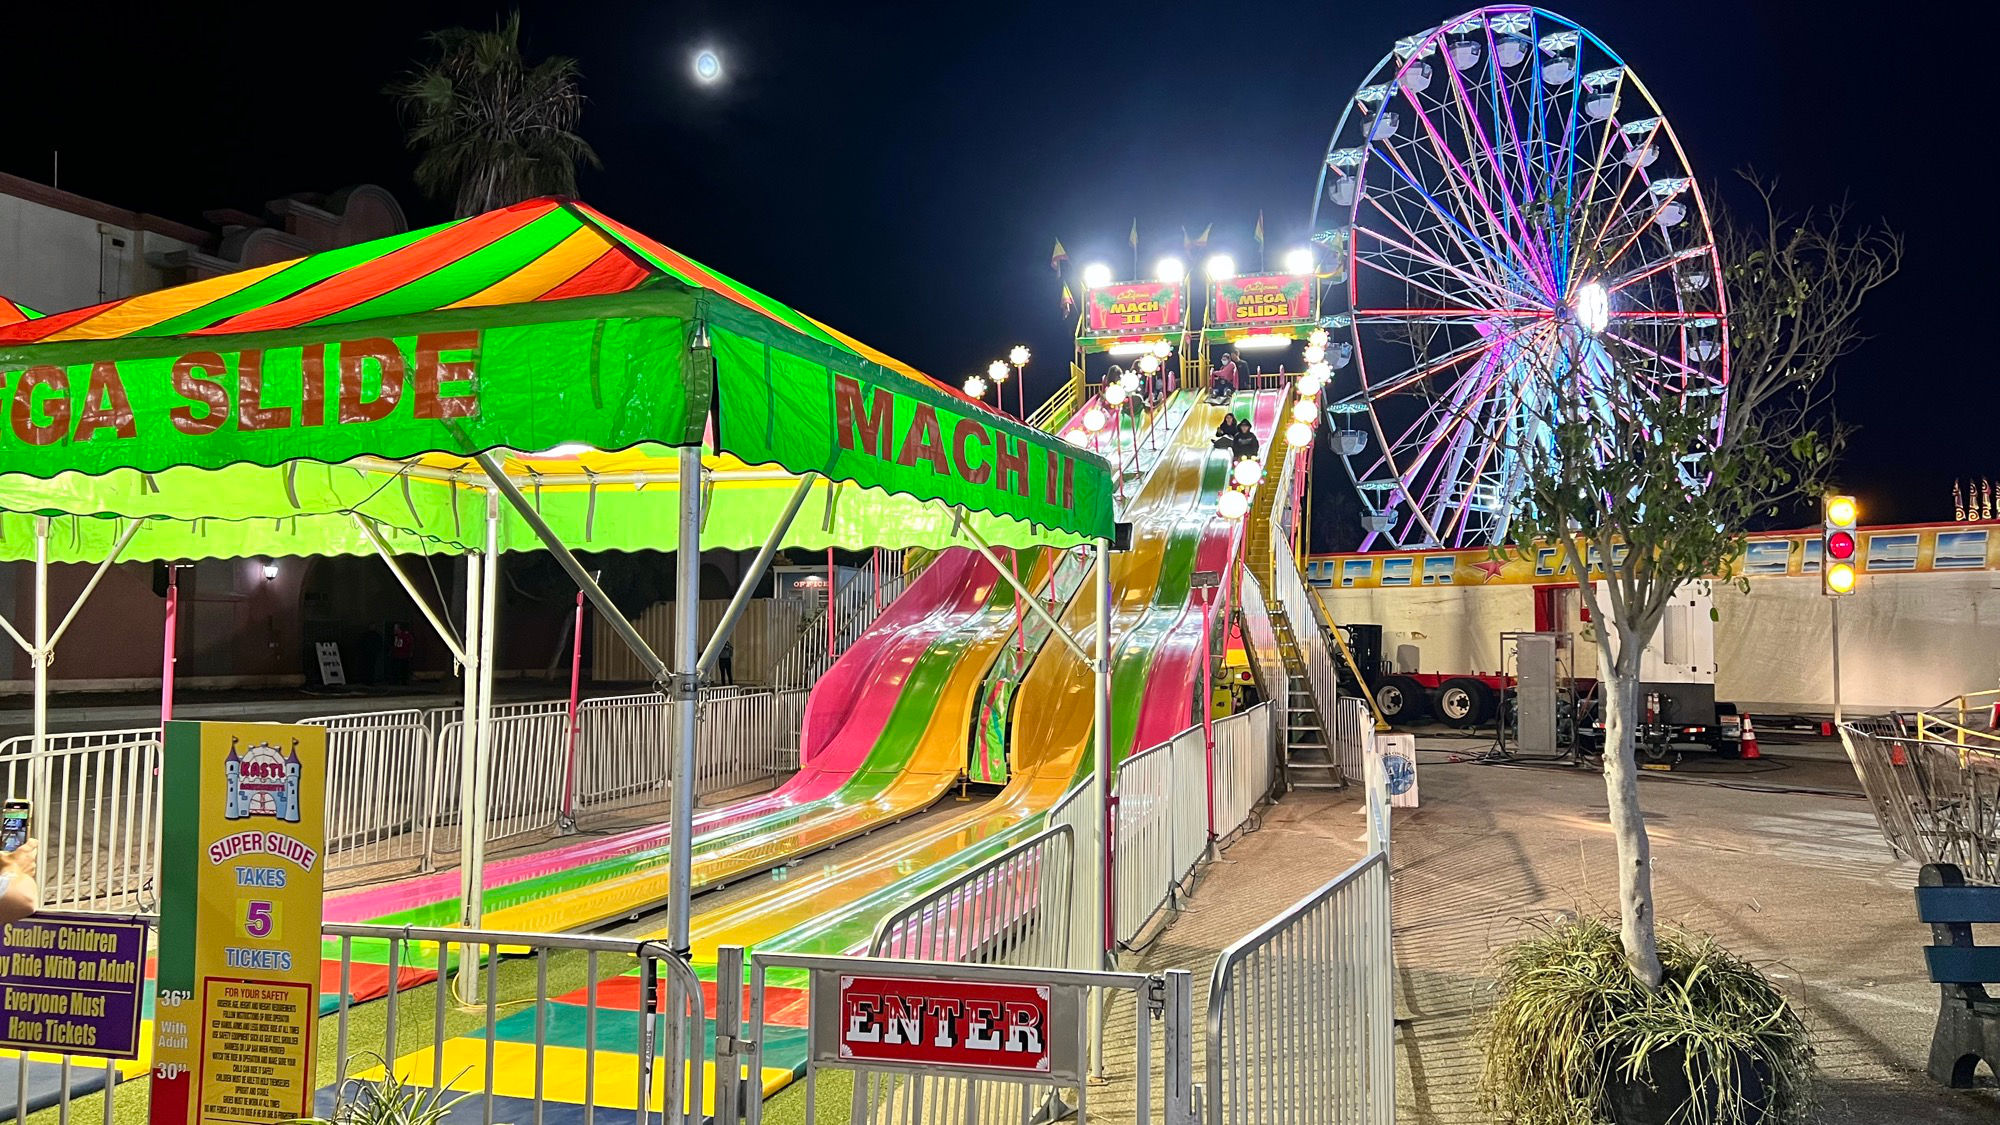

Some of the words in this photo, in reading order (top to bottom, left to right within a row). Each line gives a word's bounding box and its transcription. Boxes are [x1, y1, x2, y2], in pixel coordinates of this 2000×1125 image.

[1110, 301, 1159, 314] MACH
[1236, 304, 1289, 318] SLIDE
[1239, 293, 1287, 306] MEGA
[1121, 312, 1147, 324] II
[0, 360, 137, 446] GA
[170, 330, 481, 436] SLIDE
[834, 373, 1029, 498] MACH
[1046, 449, 1074, 510] II
[1308, 555, 1456, 588] UPER
[240, 762, 286, 778] KASTL
[209, 832, 263, 863] SUPER
[267, 833, 315, 870] SLIDE
[235, 867, 286, 888] TAKES
[245, 900, 274, 938] 5
[3, 923, 56, 949] Smaller
[58, 926, 118, 953] Children
[12, 952, 42, 978] Ride
[44, 955, 76, 980] With
[78, 960, 97, 981] an
[97, 958, 135, 984] Adult
[224, 948, 292, 971] TICKETS
[4, 987, 68, 1015] Everyone
[70, 991, 106, 1017] Must
[224, 987, 238, 998] FOR
[240, 988, 260, 999] YOUR
[261, 990, 289, 1000] SAFETY
[8, 1016, 43, 1041] Have
[45, 1019, 97, 1046] Tickets
[161, 1021, 187, 1034] With
[846, 992, 1044, 1053] ENTER
[158, 1035, 189, 1050] Adult
